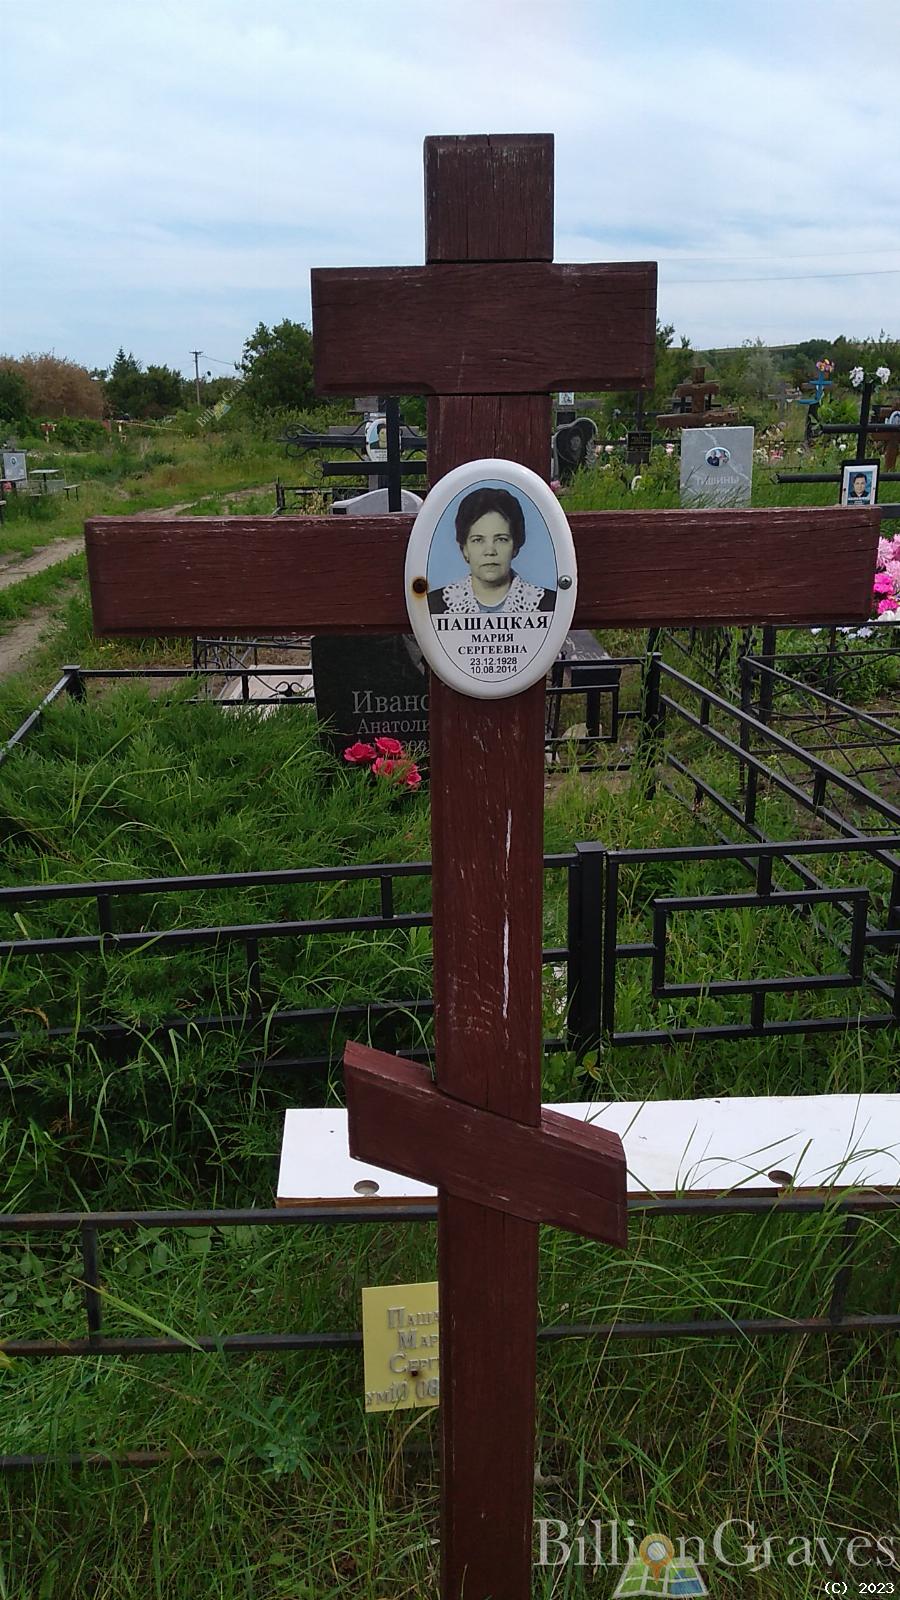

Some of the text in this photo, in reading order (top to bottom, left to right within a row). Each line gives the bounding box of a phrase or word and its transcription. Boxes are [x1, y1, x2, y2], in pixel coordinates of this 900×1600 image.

[436, 615, 549, 631] ПАШАЦКАЯ
[471, 633, 514, 643] МАРИЯ
[457, 645, 528, 655] СЕРГЕЕВНА
[470, 657, 517, 665] 23.12.1928
[470, 665, 517, 673] 10.08.2014
